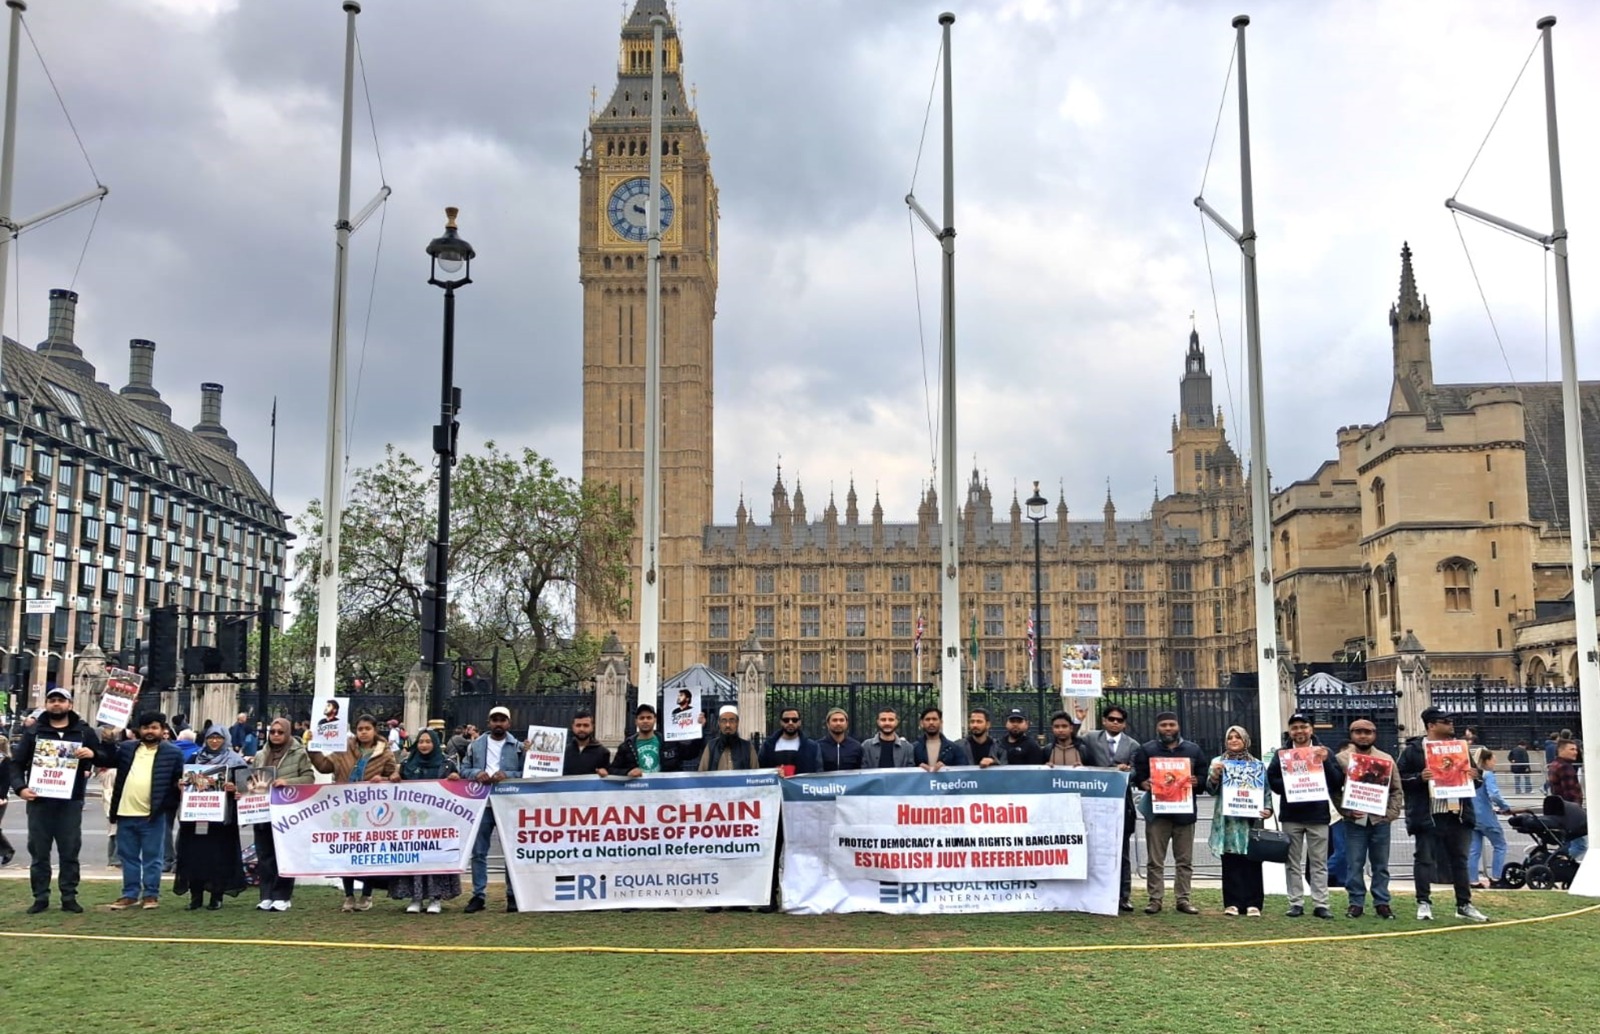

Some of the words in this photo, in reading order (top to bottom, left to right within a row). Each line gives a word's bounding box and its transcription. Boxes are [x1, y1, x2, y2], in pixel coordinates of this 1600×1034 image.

[43, 770, 63, 778] STOP
[802, 784, 847, 795] Equality
[930, 779, 978, 790] Freedom
[1052, 778, 1108, 792] Humanity
[272, 794, 340, 834] Women's
[344, 786, 388, 804] Rights
[518, 806, 645, 828] HUMAN
[657, 801, 760, 824] CHAIN
[898, 804, 965, 825] Human
[970, 803, 1028, 824] Chain
[312, 832, 340, 843] STOP
[343, 831, 362, 842] THE
[365, 830, 399, 842] ABUSE
[402, 829, 414, 840] OF
[418, 828, 459, 839] POWER:
[517, 830, 564, 844] STOP
[566, 829, 600, 843] THE
[603, 826, 660, 842] ABUSE
[663, 826, 686, 840] OF
[690, 824, 759, 839] POWER:
[839, 838, 878, 848] PROTECT
[881, 838, 935, 848] DEMOCRACY
[946, 837, 976, 848] HUMAN
[978, 837, 1012, 847] RIGHTS
[1014, 836, 1024, 846] IN
[1026, 834, 1083, 846] BANGLADESH
[329, 843, 376, 854] SUPPORT
[380, 842, 387, 852] A
[390, 840, 442, 852] NATIONAL
[516, 847, 579, 863] Support
[582, 849, 592, 858] a
[596, 844, 661, 858] National
[665, 841, 760, 856] Referendum
[351, 853, 419, 865] REFERENDUM
[855, 852, 933, 868] ESTABLISH
[937, 851, 967, 868] JULY
[971, 849, 1069, 868] REFERENDUM
[614, 874, 663, 889] EQUAL
[666, 873, 719, 886] RIGHTS
[934, 881, 982, 892] EQUAL
[986, 880, 1038, 890] RIGHTS
[614, 888, 720, 897] INTERNATIONAL
[934, 892, 1038, 902] INTERNATIONAL
